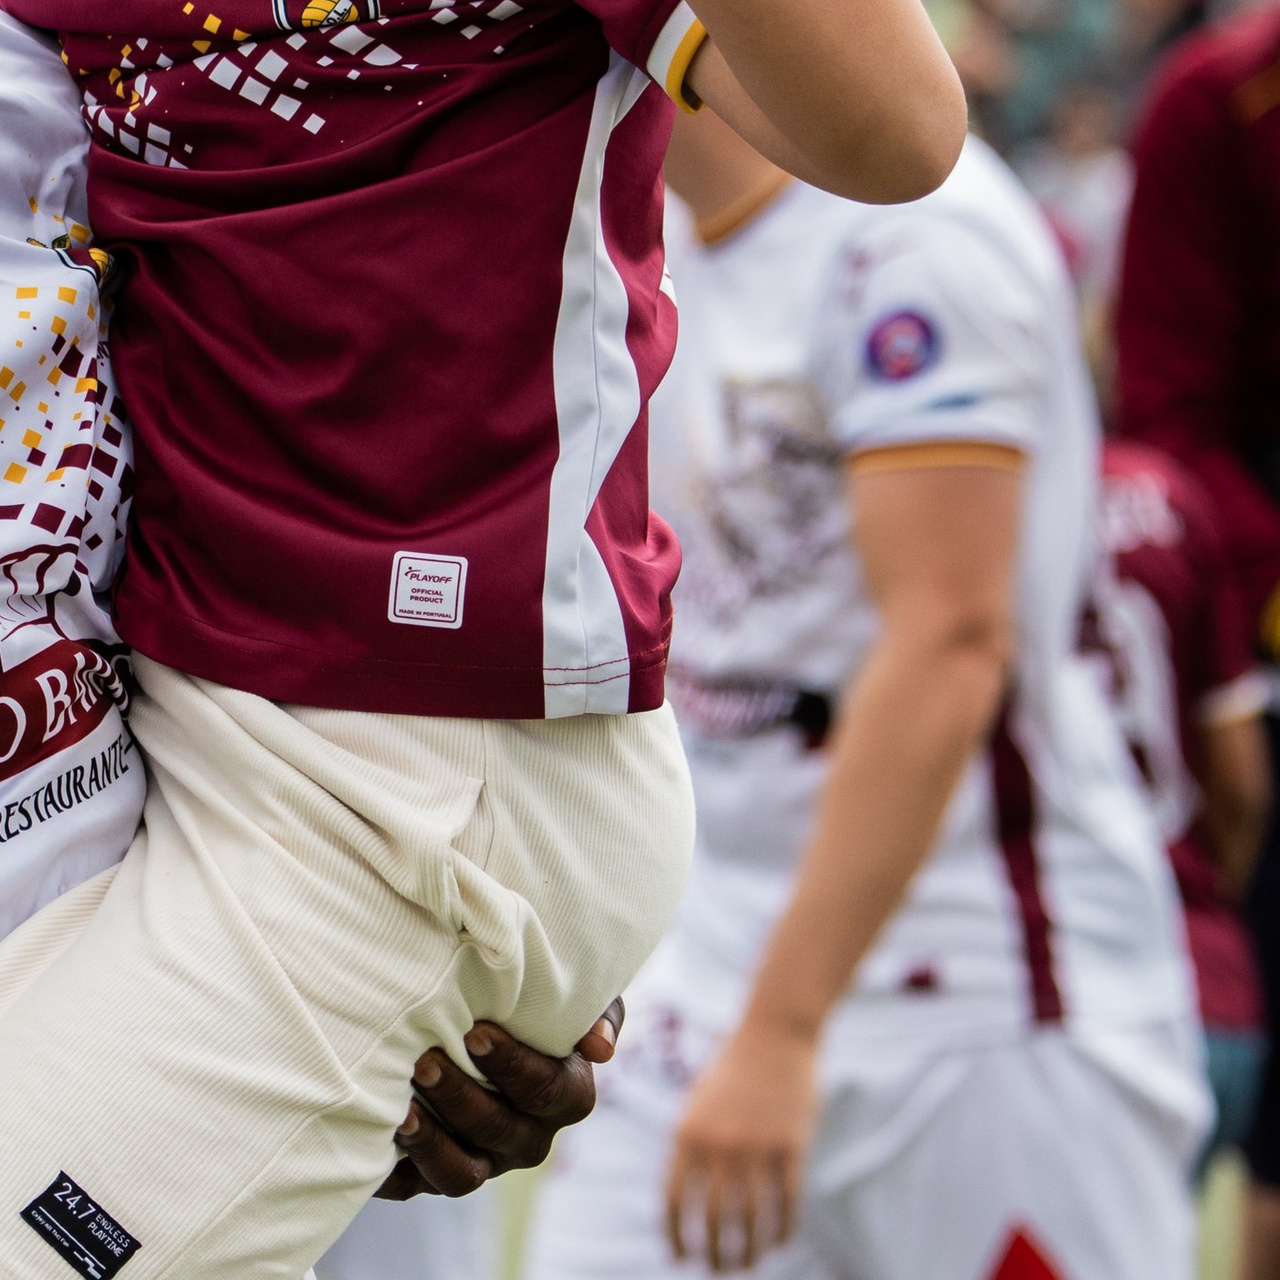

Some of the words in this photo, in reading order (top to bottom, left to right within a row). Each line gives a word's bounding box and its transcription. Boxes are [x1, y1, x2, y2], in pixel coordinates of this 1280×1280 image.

[410, 573, 452, 584] PLAYOFF
[411, 588, 443, 596] OFFICIAL
[423, 611, 452, 619] PORTUGAL
[53, 1182, 97, 1220] 24.7
[87, 1221, 124, 1257] PLAYTIME
[95, 1213, 130, 1248] ENDLESS
